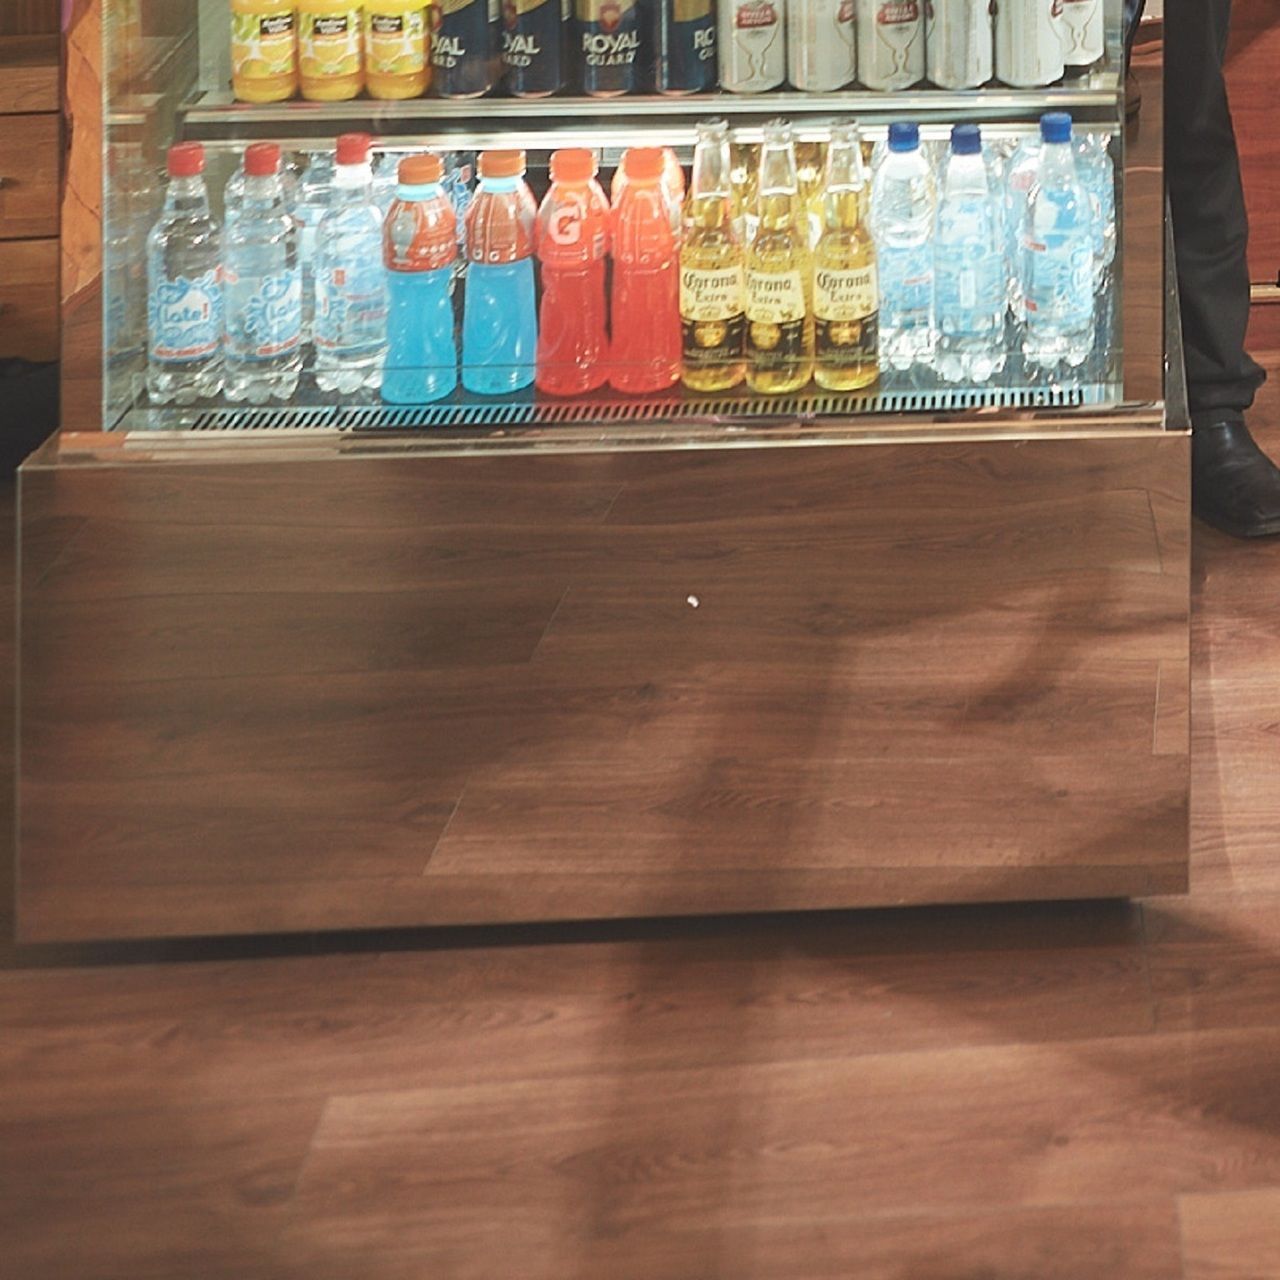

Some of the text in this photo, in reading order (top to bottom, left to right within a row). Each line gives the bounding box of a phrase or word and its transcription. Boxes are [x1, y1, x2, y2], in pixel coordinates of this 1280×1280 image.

[582, 29, 641, 53] ROYAL
[586, 50, 635, 67] GUARD
[683, 271, 738, 290] Corona
[816, 271, 871, 290] Corona
